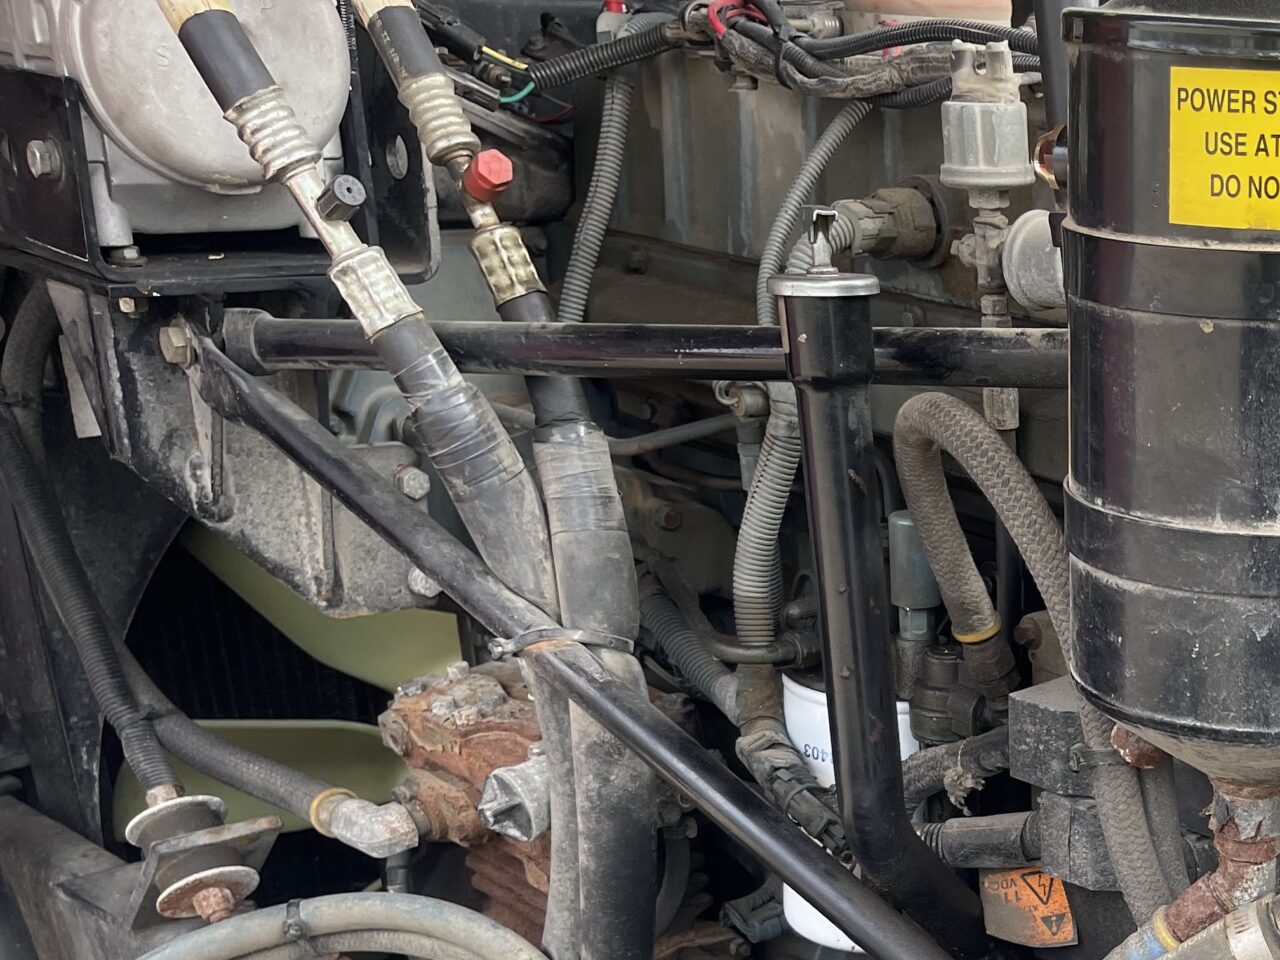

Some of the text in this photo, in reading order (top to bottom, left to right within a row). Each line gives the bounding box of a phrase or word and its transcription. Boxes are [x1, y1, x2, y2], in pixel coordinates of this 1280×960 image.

[1177, 87, 1256, 113] POWER
[1204, 132, 1248, 156] USE
[1210, 174, 1241, 198] DO
[804, 743, 832, 763] 403
